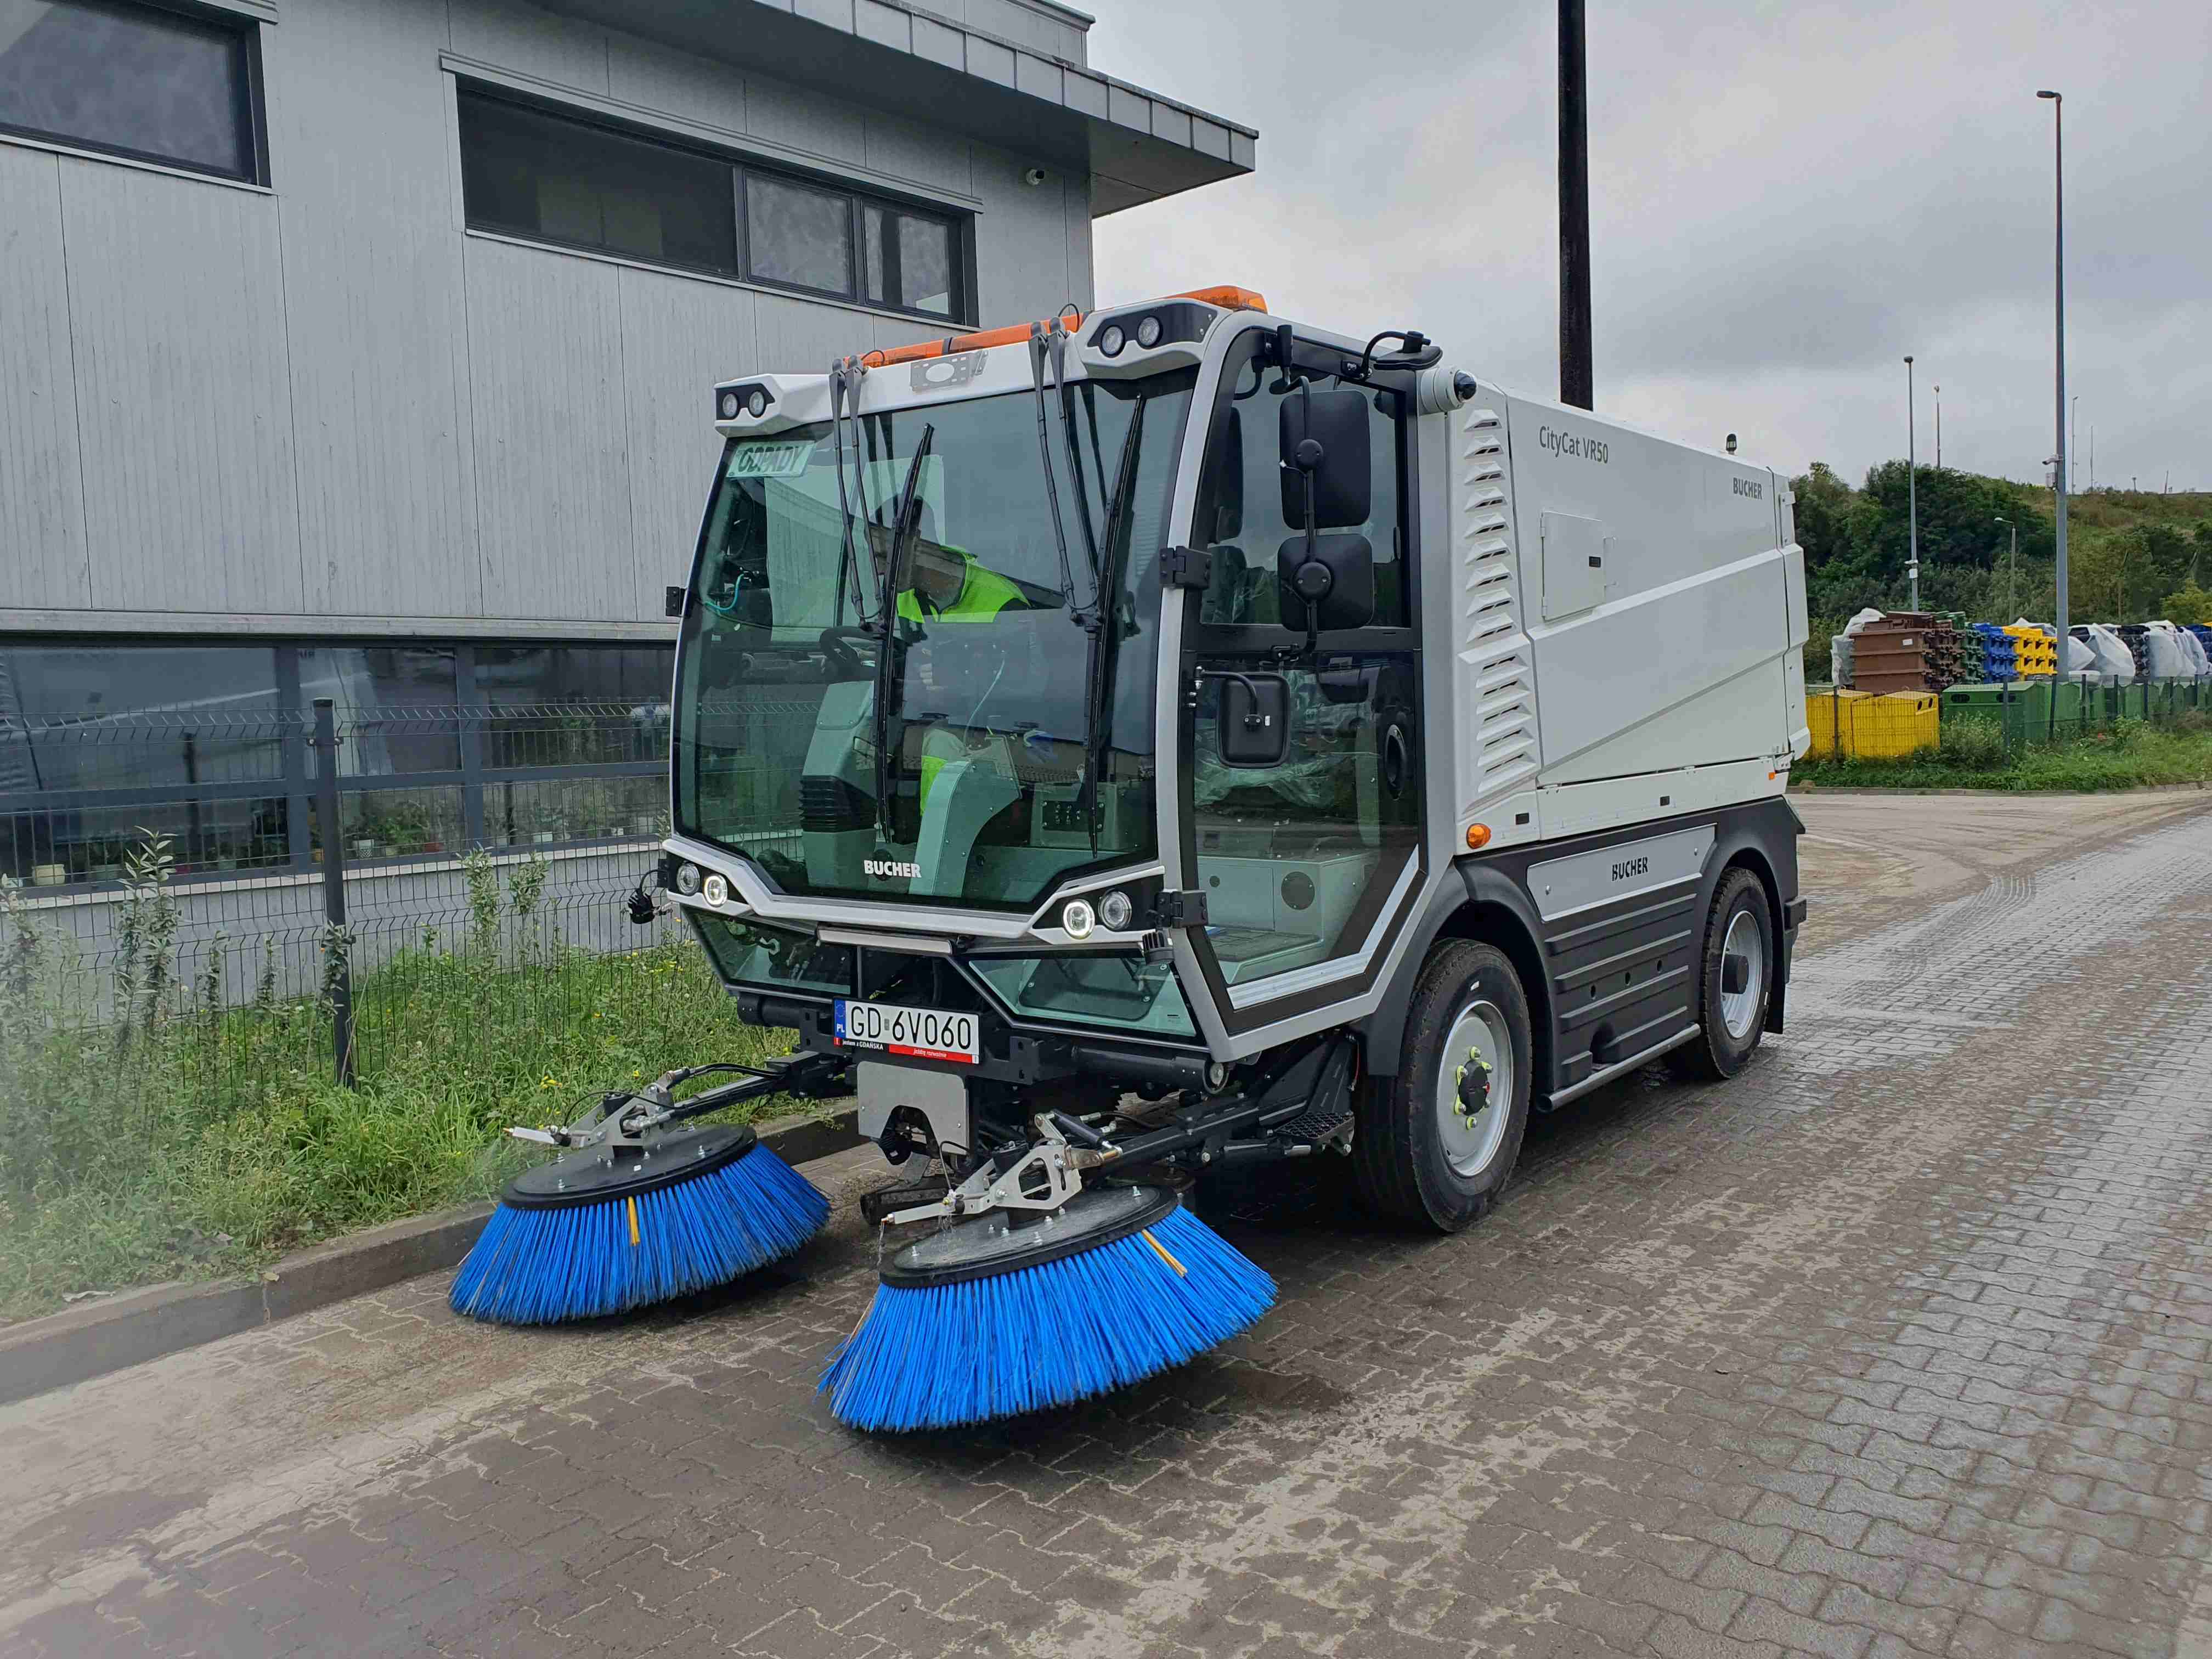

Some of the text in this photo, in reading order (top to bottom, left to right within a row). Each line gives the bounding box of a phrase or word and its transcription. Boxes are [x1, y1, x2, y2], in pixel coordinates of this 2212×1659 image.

[1539, 426, 1609, 464] CityCat VR50
[1733, 477, 1763, 500] BUCHER
[864, 860, 922, 878] BUCHER
[1612, 856, 1648, 881] BUCHER
[837, 1023, 845, 1032] PL
[851, 1006, 971, 1049] GD 6V060
